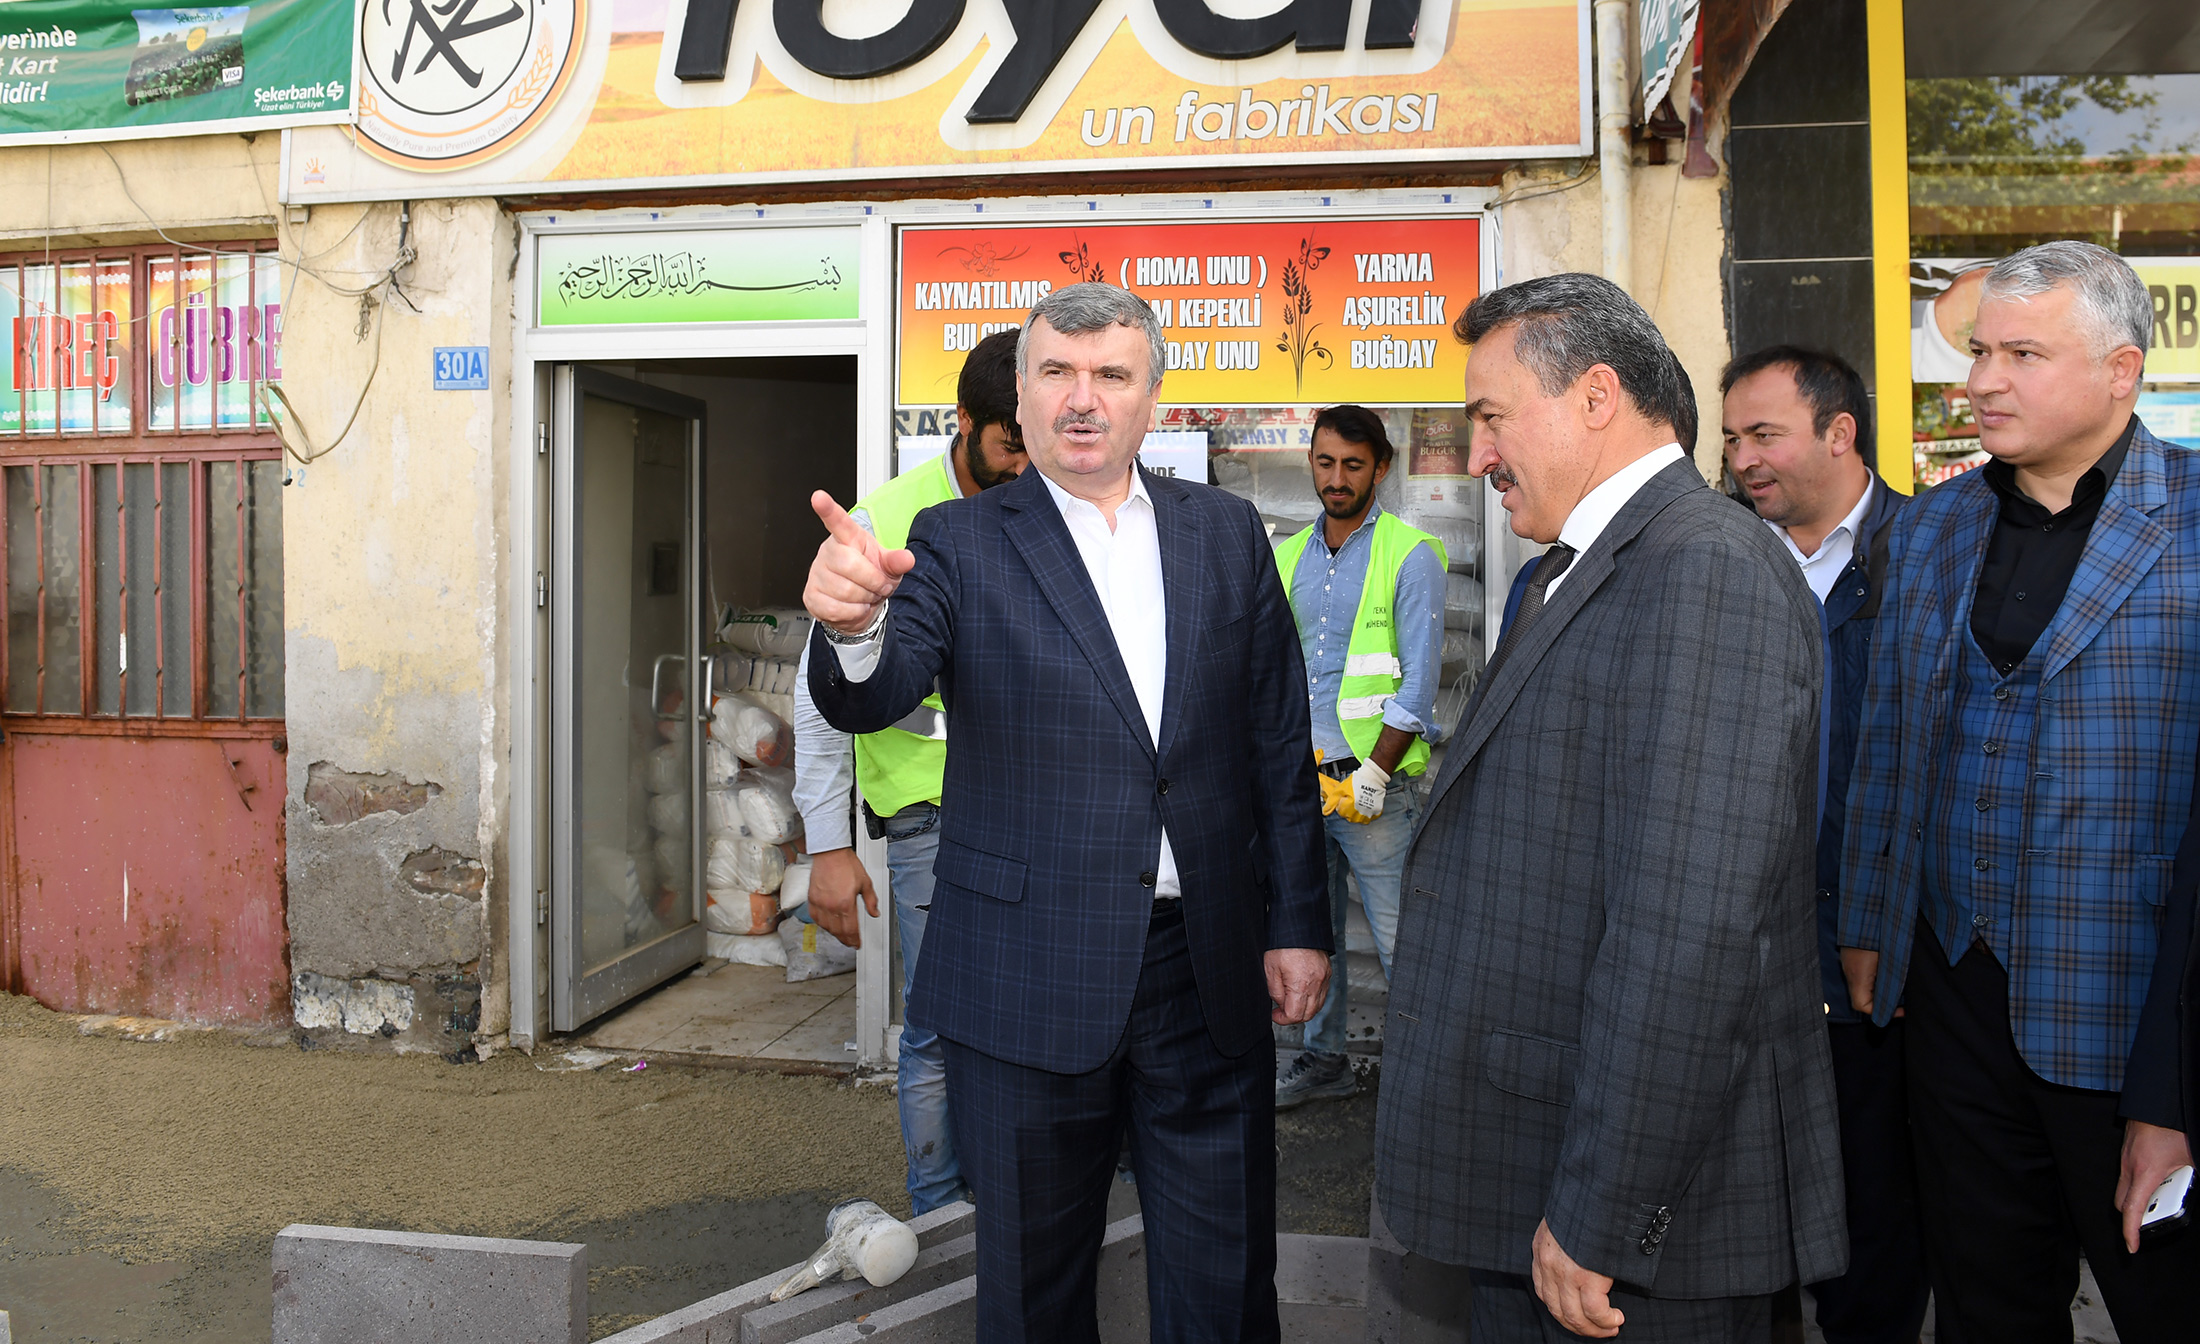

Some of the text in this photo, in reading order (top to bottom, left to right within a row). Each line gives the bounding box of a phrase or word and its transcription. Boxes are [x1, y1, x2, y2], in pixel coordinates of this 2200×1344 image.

[8, 55, 59, 76] Kart
[224, 69, 242, 79] VISA
[254, 82, 325, 107] Şekerbank
[1080, 84, 1439, 147] un fabrikası
[366, 114, 519, 153] Naturally Pure and Premium Quality
[1136, 256, 1200, 286] HOMA
[1206, 255, 1251, 285] UNU
[1353, 252, 1434, 283] YARMA
[1178, 292, 1262, 328] KEPEKLİ
[1342, 290, 1447, 331] AŞURELİK
[1214, 340, 1260, 371] UNU
[1350, 334, 1438, 370] BUĞDAY
[1425, 423, 1453, 436] DURU
[1420, 447, 1457, 456] BULGUR
